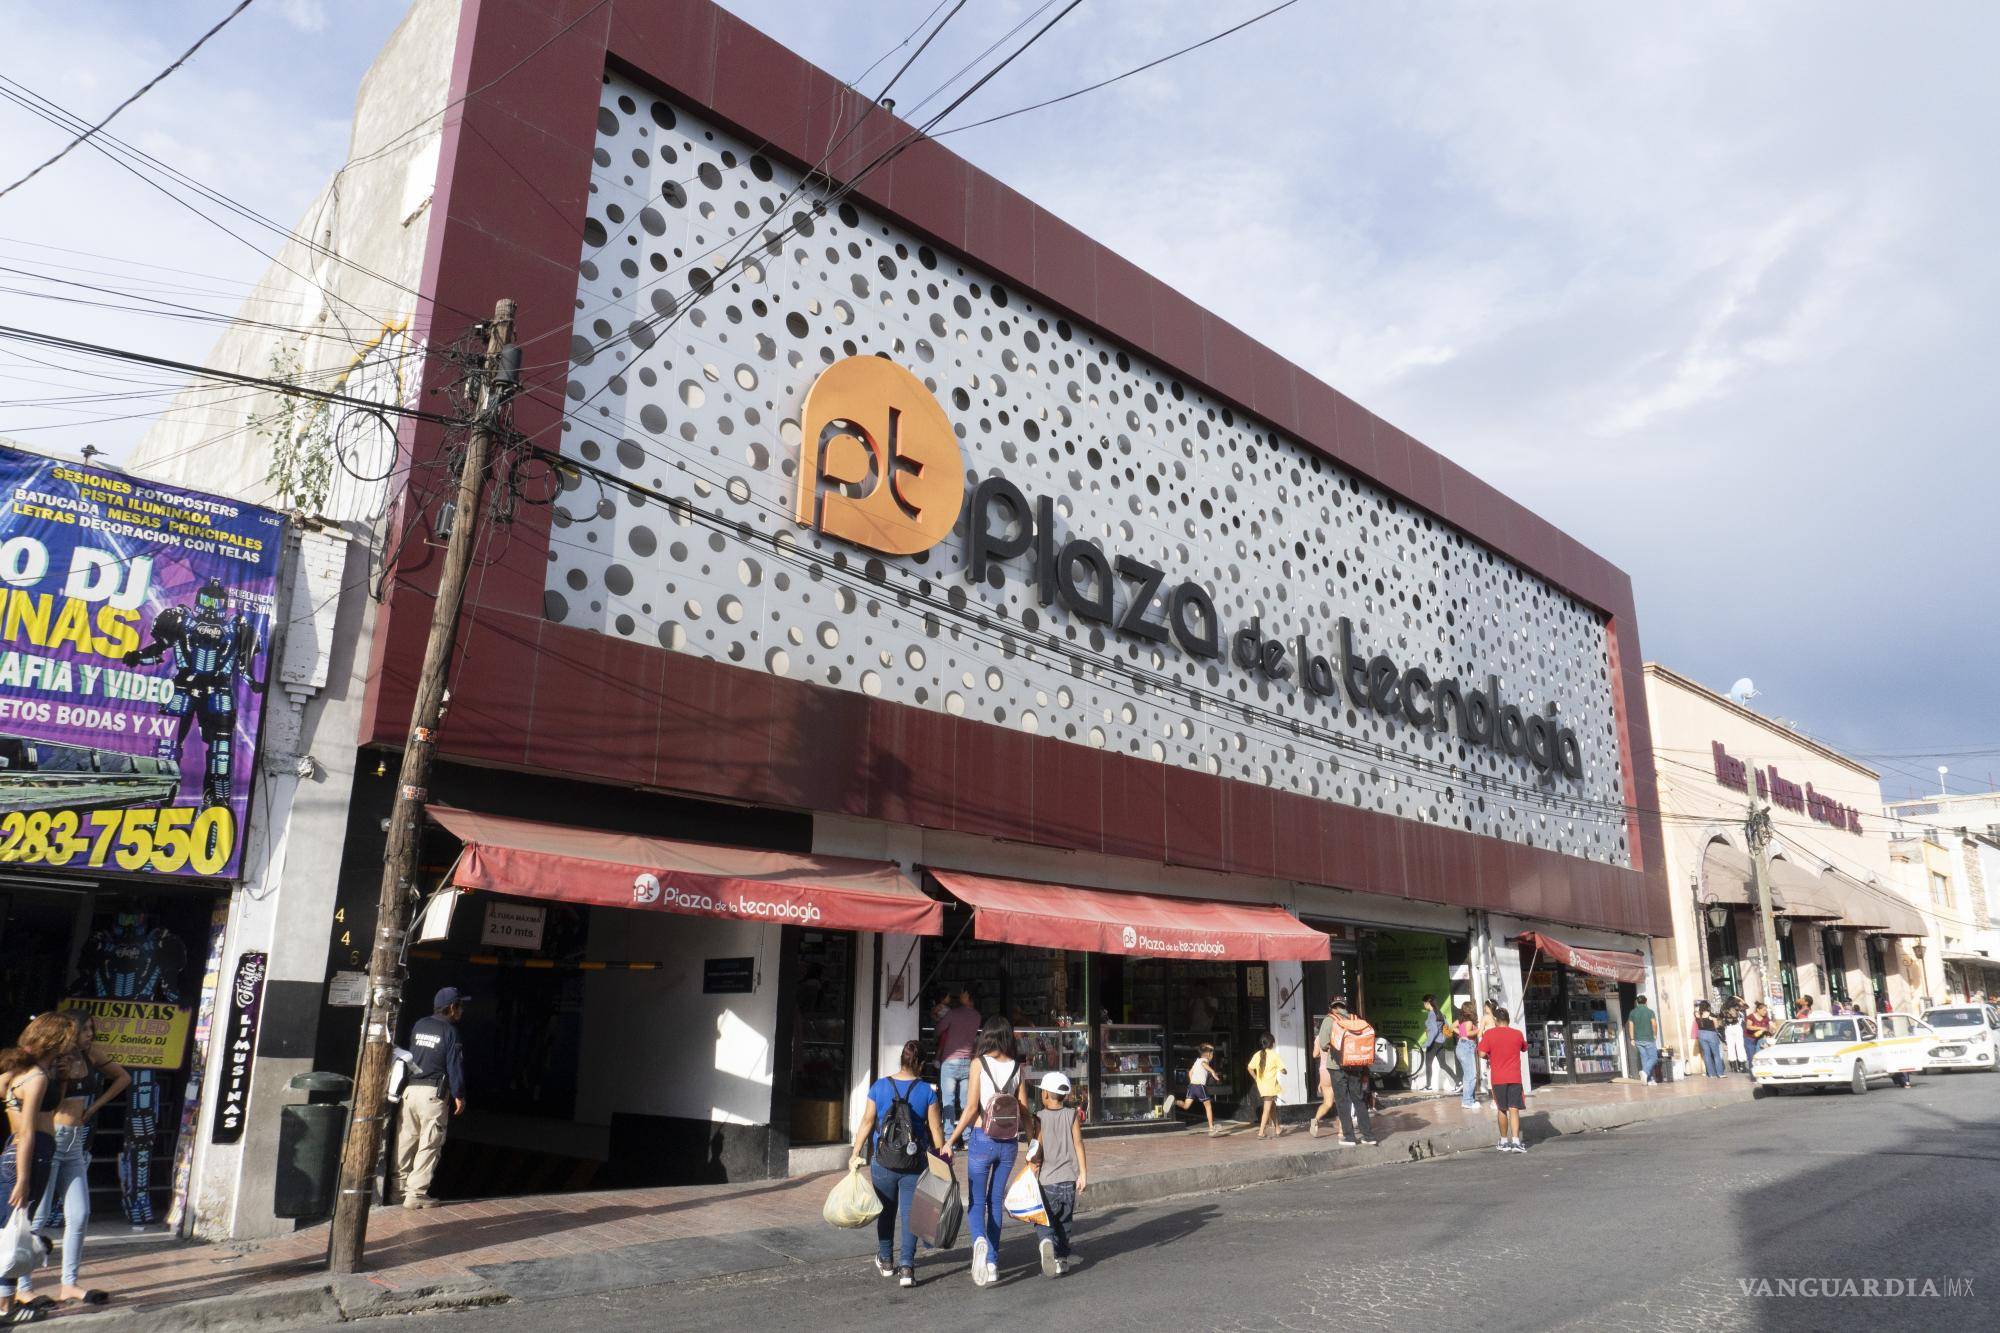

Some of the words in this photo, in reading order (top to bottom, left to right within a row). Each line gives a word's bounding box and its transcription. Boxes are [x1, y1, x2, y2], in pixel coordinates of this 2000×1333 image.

[52, 467, 132, 494] SESIONES
[135, 486, 239, 518] FOTOPOSTERS
[80, 488, 124, 507] PISTA
[128, 498, 212, 526] ILUMINADA
[13, 502, 75, 524] LETRAS
[79, 515, 181, 546] DECORACION
[184, 538, 216, 554] CON
[218, 544, 261, 563] TELAS
[14, 488, 100, 516] BATUCADA
[107, 507, 161, 528] MESAS
[168, 520, 263, 551] PRINCIPALES
[64, 546, 153, 611] DJ
[967, 476, 1219, 659] Plaza
[1234, 615, 1292, 680] de
[1296, 634, 1334, 697] la
[80, 664, 102, 695] Y
[103, 668, 175, 704] VIDEO
[56, 705, 127, 731] BODAS
[132, 715, 145, 734] Y
[148, 718, 177, 738] XV
[1711, 739, 1768, 800] MERCDO
[663, 886, 712, 910] Plaza
[714, 899, 727, 912] de
[1139, 935, 1165, 951] Plaza
[120, 1035, 152, 1045] Sonido
[154, 1036, 168, 1046] DJ
[223, 1014, 252, 1129] LIMUSINAS
